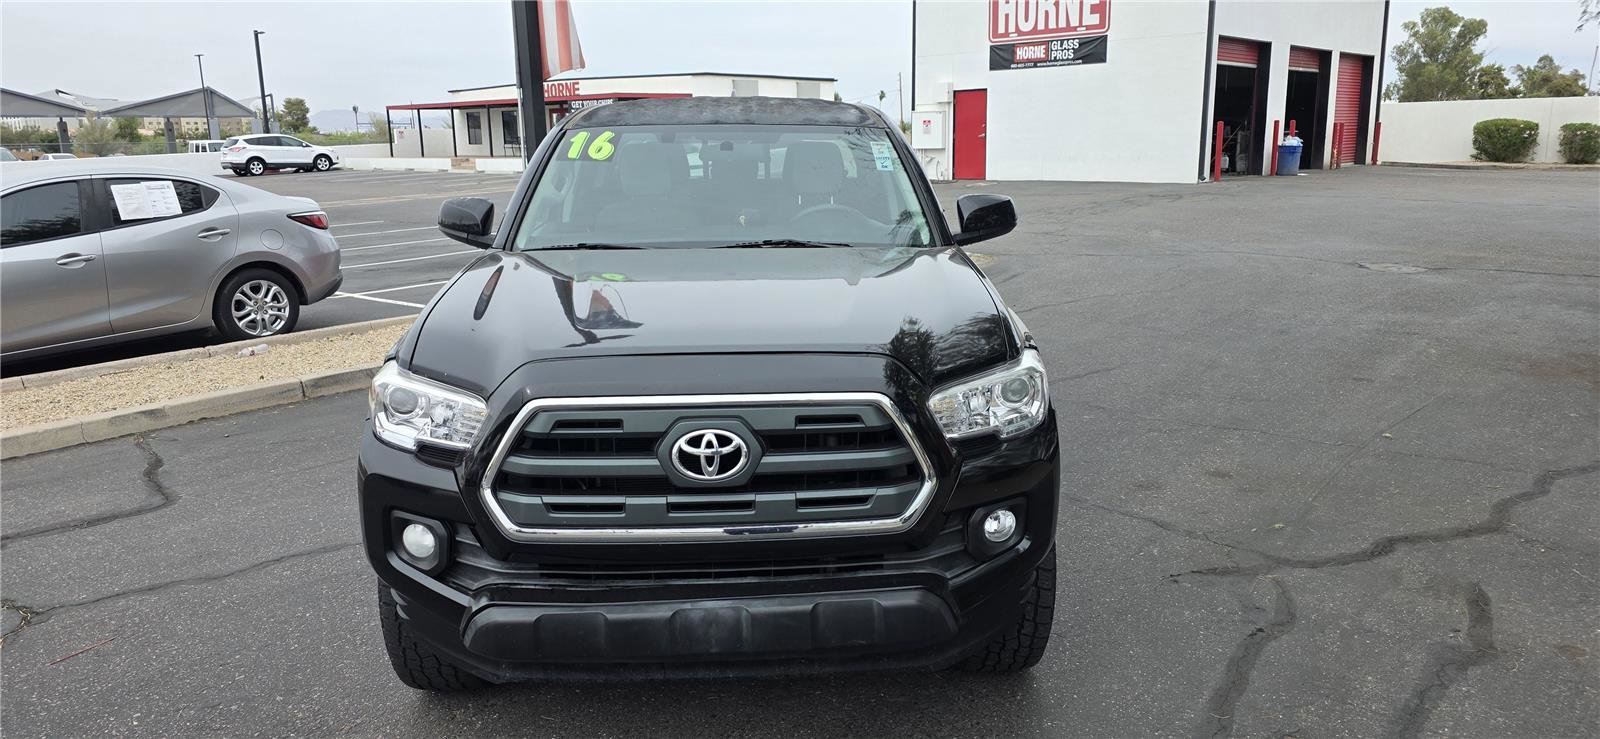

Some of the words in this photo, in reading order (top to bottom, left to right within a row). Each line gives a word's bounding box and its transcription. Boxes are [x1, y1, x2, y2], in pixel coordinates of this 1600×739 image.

[998, 0, 1100, 34] HORNE
[1051, 39, 1079, 50] GLASS
[1016, 45, 1046, 60] HORNE
[1051, 49, 1074, 60] PROS
[568, 131, 615, 160] 16
